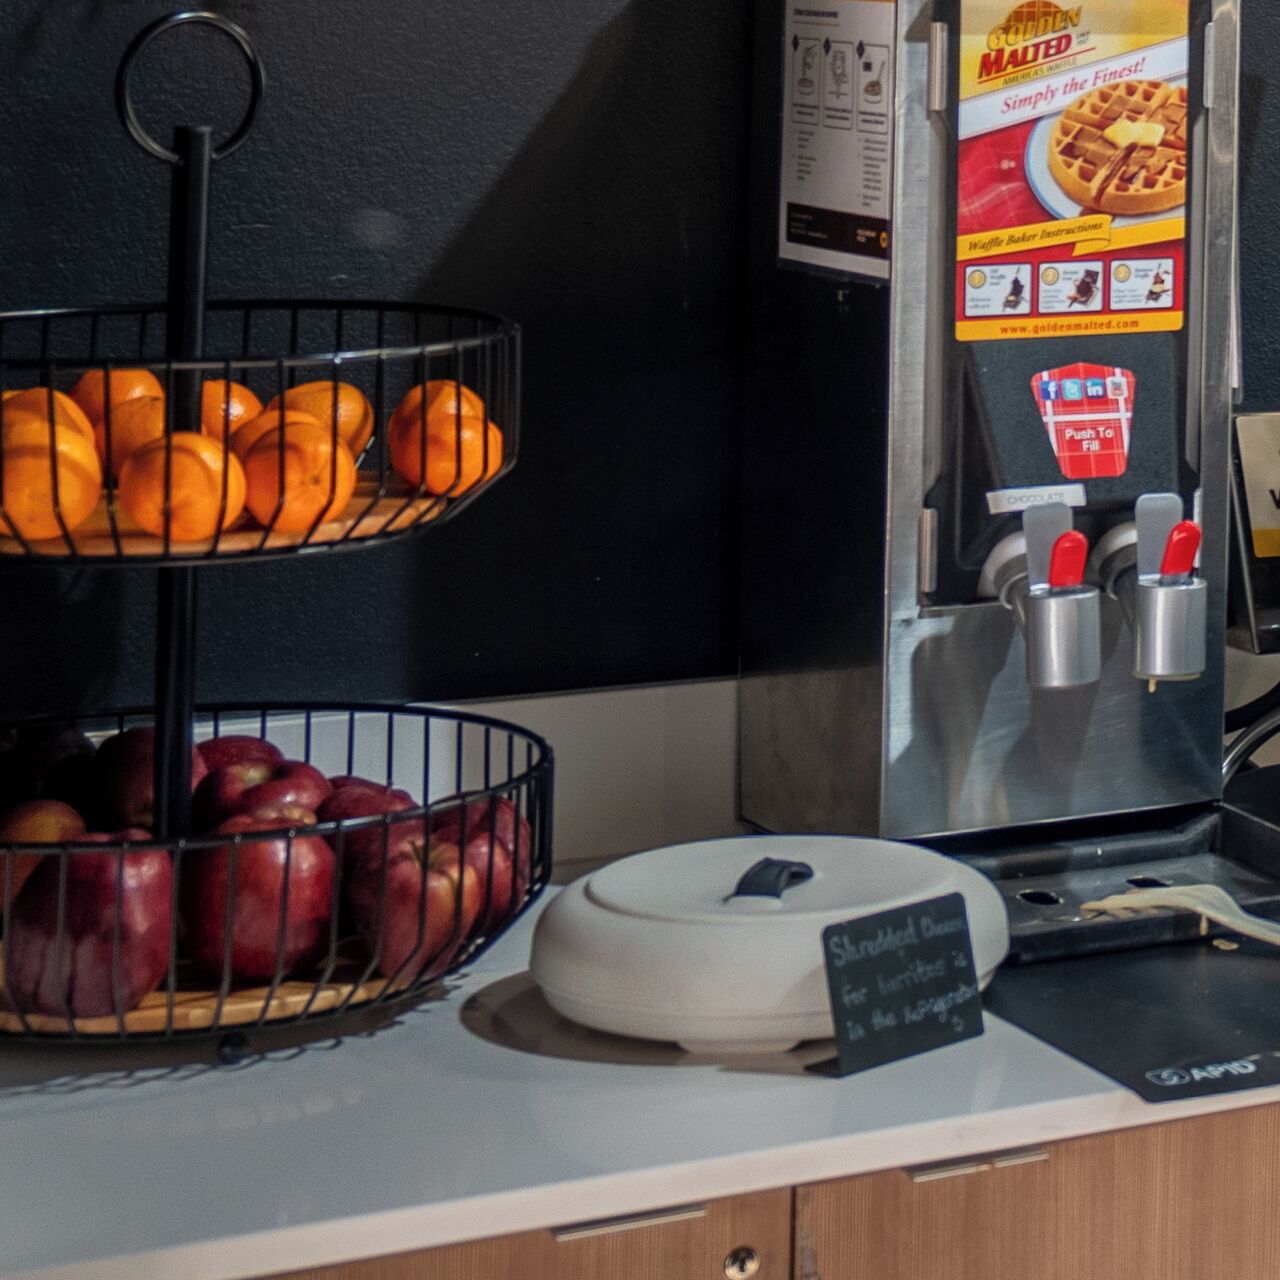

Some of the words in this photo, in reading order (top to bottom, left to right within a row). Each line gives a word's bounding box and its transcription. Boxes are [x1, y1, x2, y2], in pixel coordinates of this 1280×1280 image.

[987, 5, 1082, 52] GOLDEN
[977, 33, 1073, 79] MALTED
[1000, 83, 1060, 115] Simply
[1062, 76, 1088, 96] the
[1091, 57, 1147, 87] Finest!
[968, 235, 1002, 252] Waffle
[1006, 231, 1039, 246] Baker
[1040, 221, 1104, 240] Instructions
[1000, 319, 1140, 335] www.goldenmalted.com
[1065, 427, 1095, 440] Push
[1097, 427, 1114, 439] To
[1082, 440, 1100, 452] Fill
[1007, 493, 1065, 505] CHOCOLATE
[830, 916, 919, 967] Shredded
[871, 1007, 897, 1032] the
